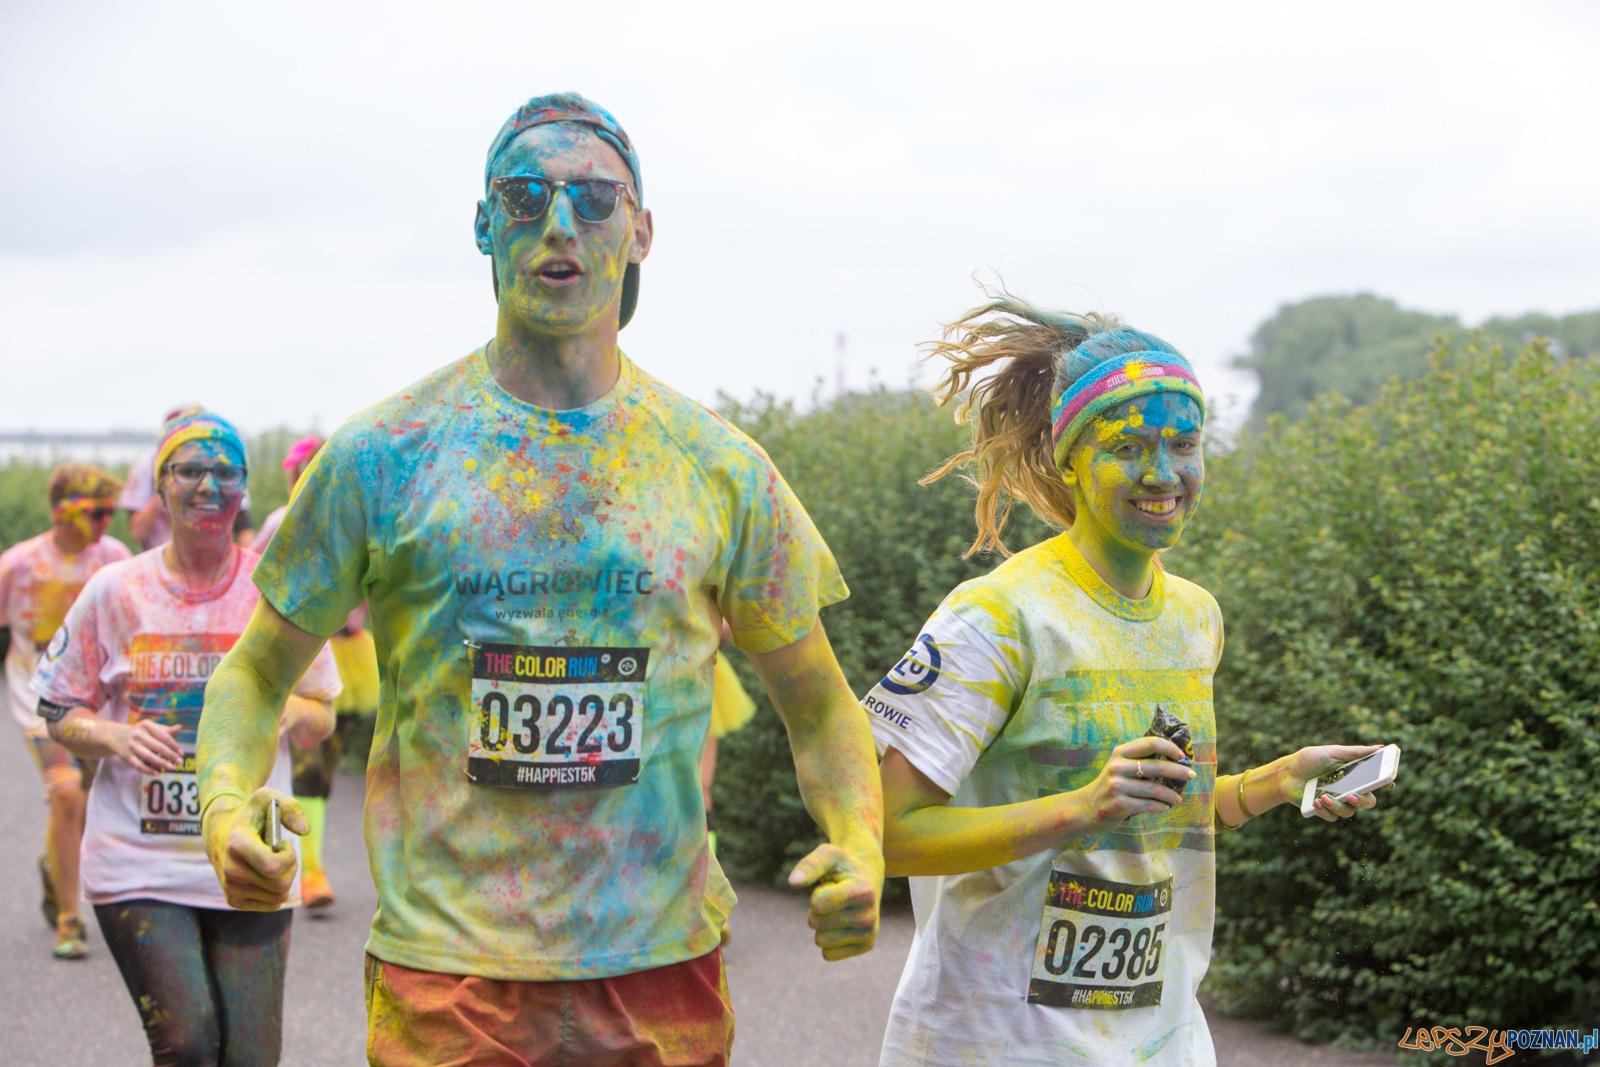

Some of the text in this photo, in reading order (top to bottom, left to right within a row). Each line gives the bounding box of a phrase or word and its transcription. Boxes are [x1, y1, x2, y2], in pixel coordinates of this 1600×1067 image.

[1107, 366, 1164, 388] COLO UNNER
[455, 569, 654, 602] WĄGROWIEC
[495, 607, 554, 621] wyzwala
[129, 654, 156, 679] HE
[484, 652, 598, 678] THE COLOR RUN
[479, 691, 634, 755] 03223
[516, 766, 597, 784] #HAPPIEST5K
[1060, 881, 1087, 907] THE
[1087, 888, 1135, 913] COLOR
[1133, 893, 1154, 913] RUN
[1043, 919, 1166, 981] 02385
